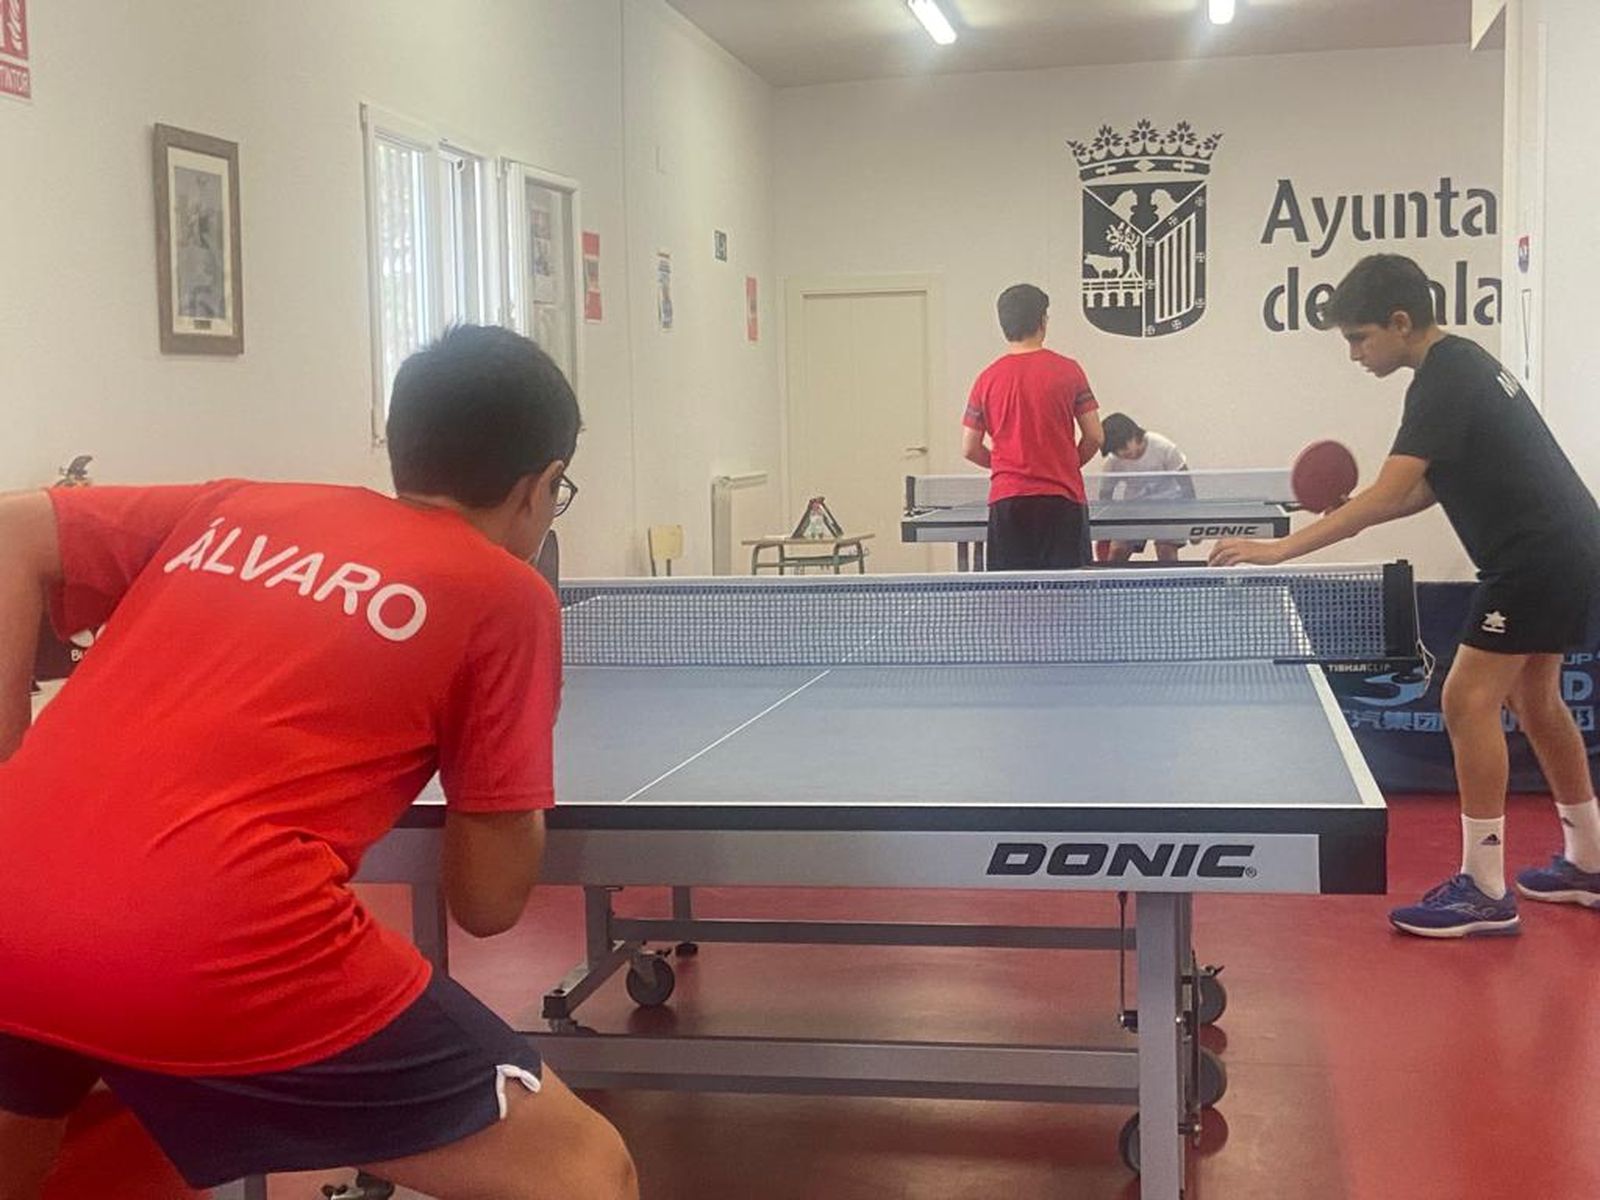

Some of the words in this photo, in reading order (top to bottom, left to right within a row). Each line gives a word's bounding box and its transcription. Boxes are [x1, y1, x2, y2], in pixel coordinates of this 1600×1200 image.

[1260, 176, 1498, 258] Ayunta
[1190, 526, 1260, 537] DONIC
[163, 516, 428, 642] ÁLVARO
